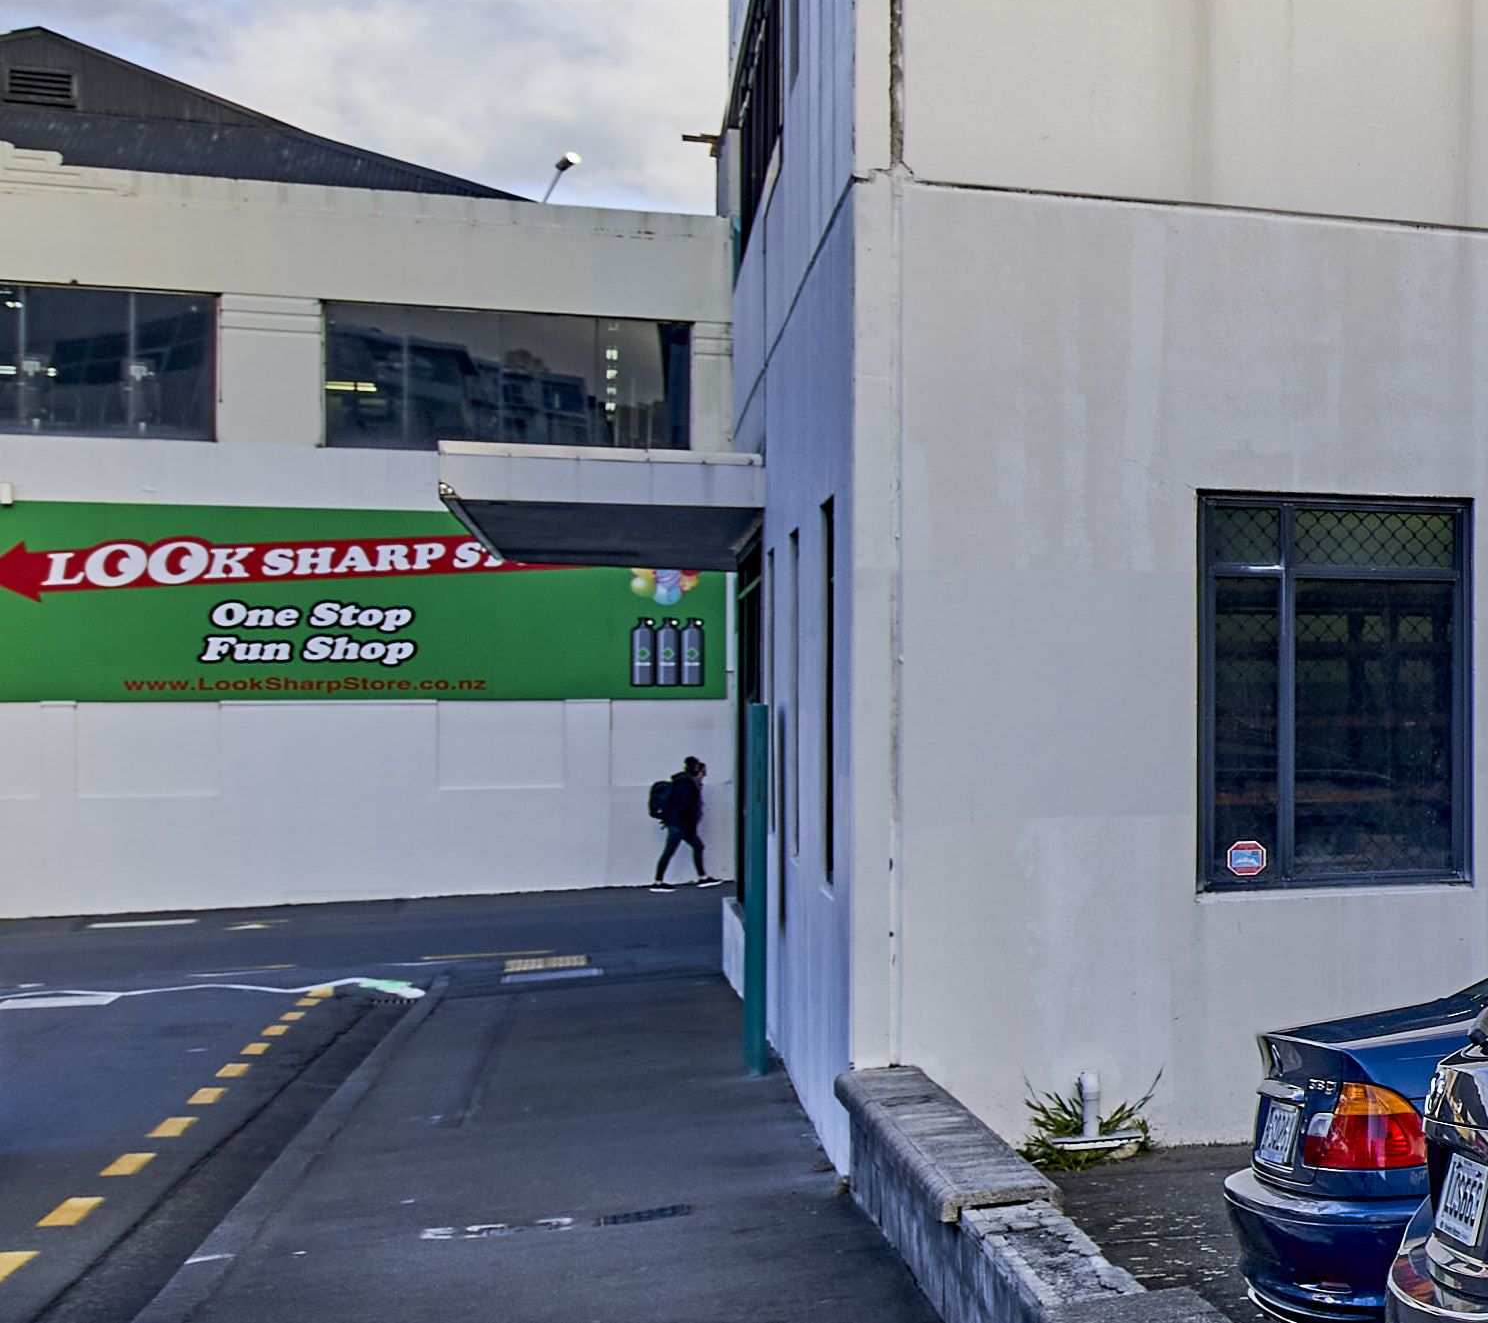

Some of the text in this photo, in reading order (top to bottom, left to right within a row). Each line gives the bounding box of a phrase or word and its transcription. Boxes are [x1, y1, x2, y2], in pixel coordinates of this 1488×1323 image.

[41, 541, 255, 587] LOOK
[261, 543, 446, 576] SHARP
[210, 600, 414, 633] One Stop
[200, 635, 415, 665] Fun Shop
[123, 677, 487, 693] www.LookSharpStore.co.nz
